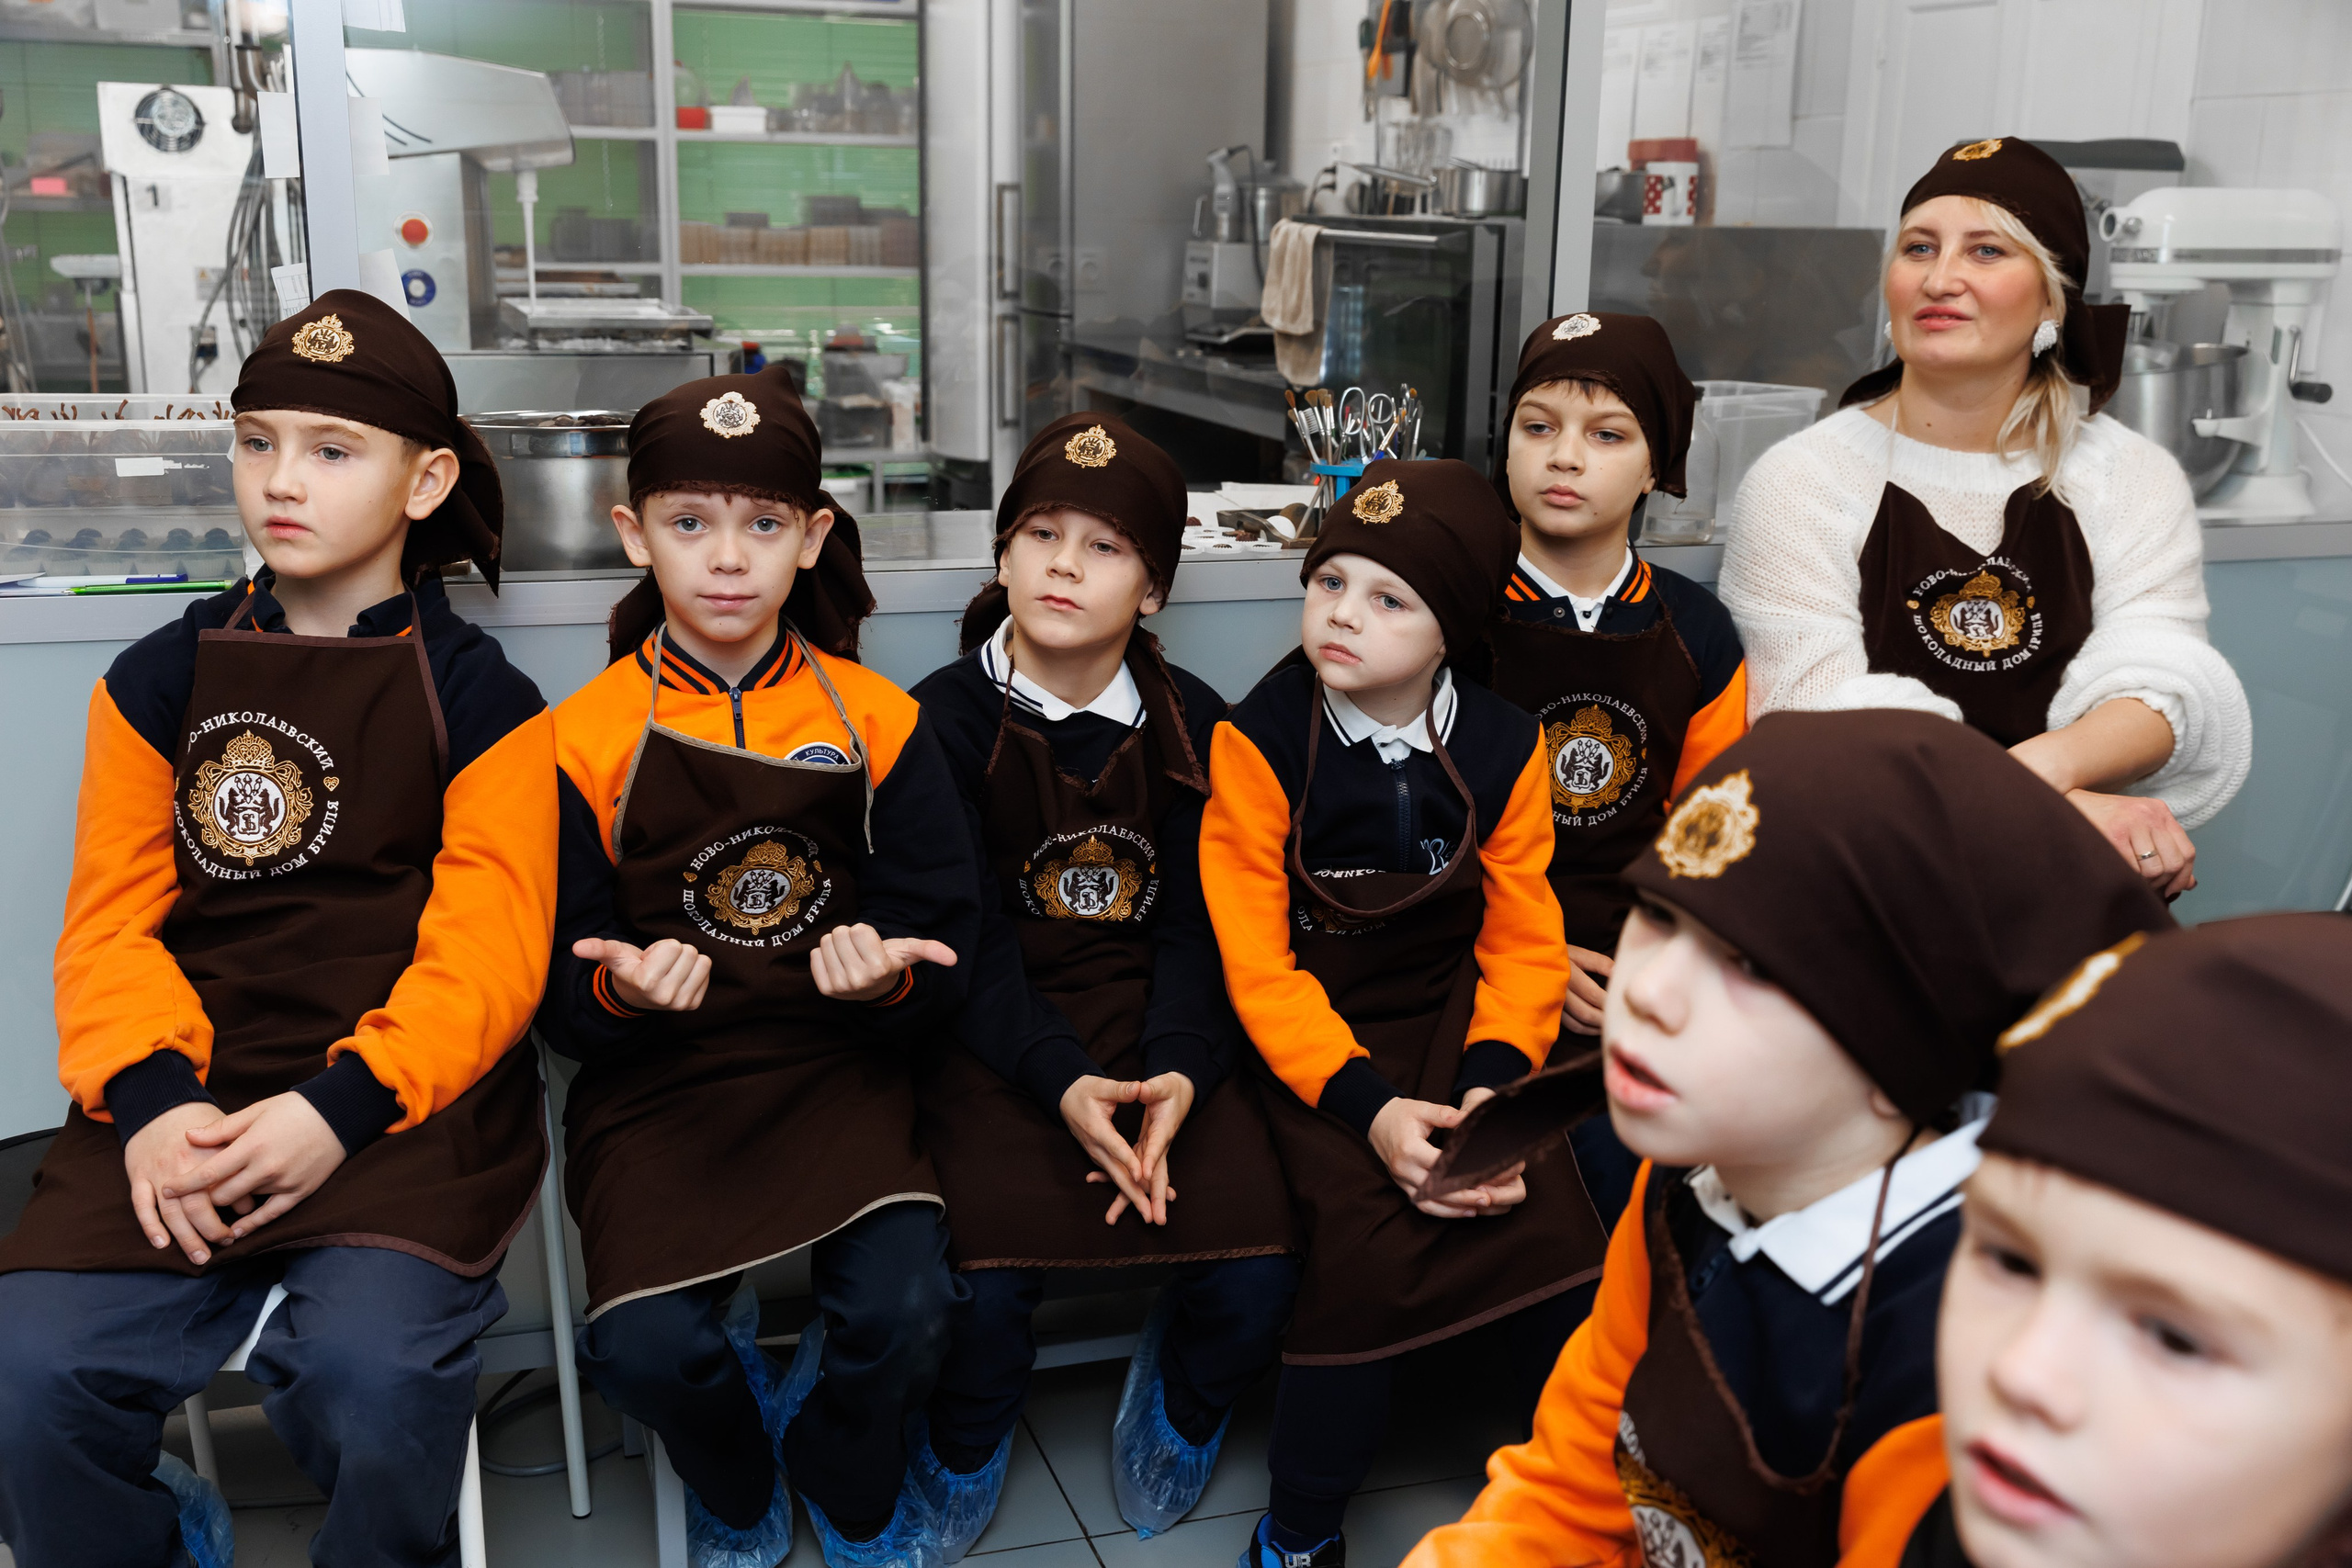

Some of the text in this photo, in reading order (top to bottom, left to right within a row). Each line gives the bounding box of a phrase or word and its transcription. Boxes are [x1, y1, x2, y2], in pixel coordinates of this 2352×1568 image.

[1914, 614, 1996, 672] ШОКОЛАДНЫЙ
[2002, 648, 2033, 671] ДОМ
[187, 711, 334, 771] О-НИКОЛАЕВСКИЙ
[805, 748, 840, 761] КУЛЬТУРА
[1588, 807, 1618, 827] ДОМ
[1620, 766, 1648, 807] БРИЛЯ
[174, 800, 339, 881] ШОКОЛАДНЫЙ ДОМ БРИЛЯ
[683, 878, 831, 947] ШОКОЛАДНЫЙ ДОМ БРИЛЯ
[1134, 878, 1159, 922] БРИЛЯ
